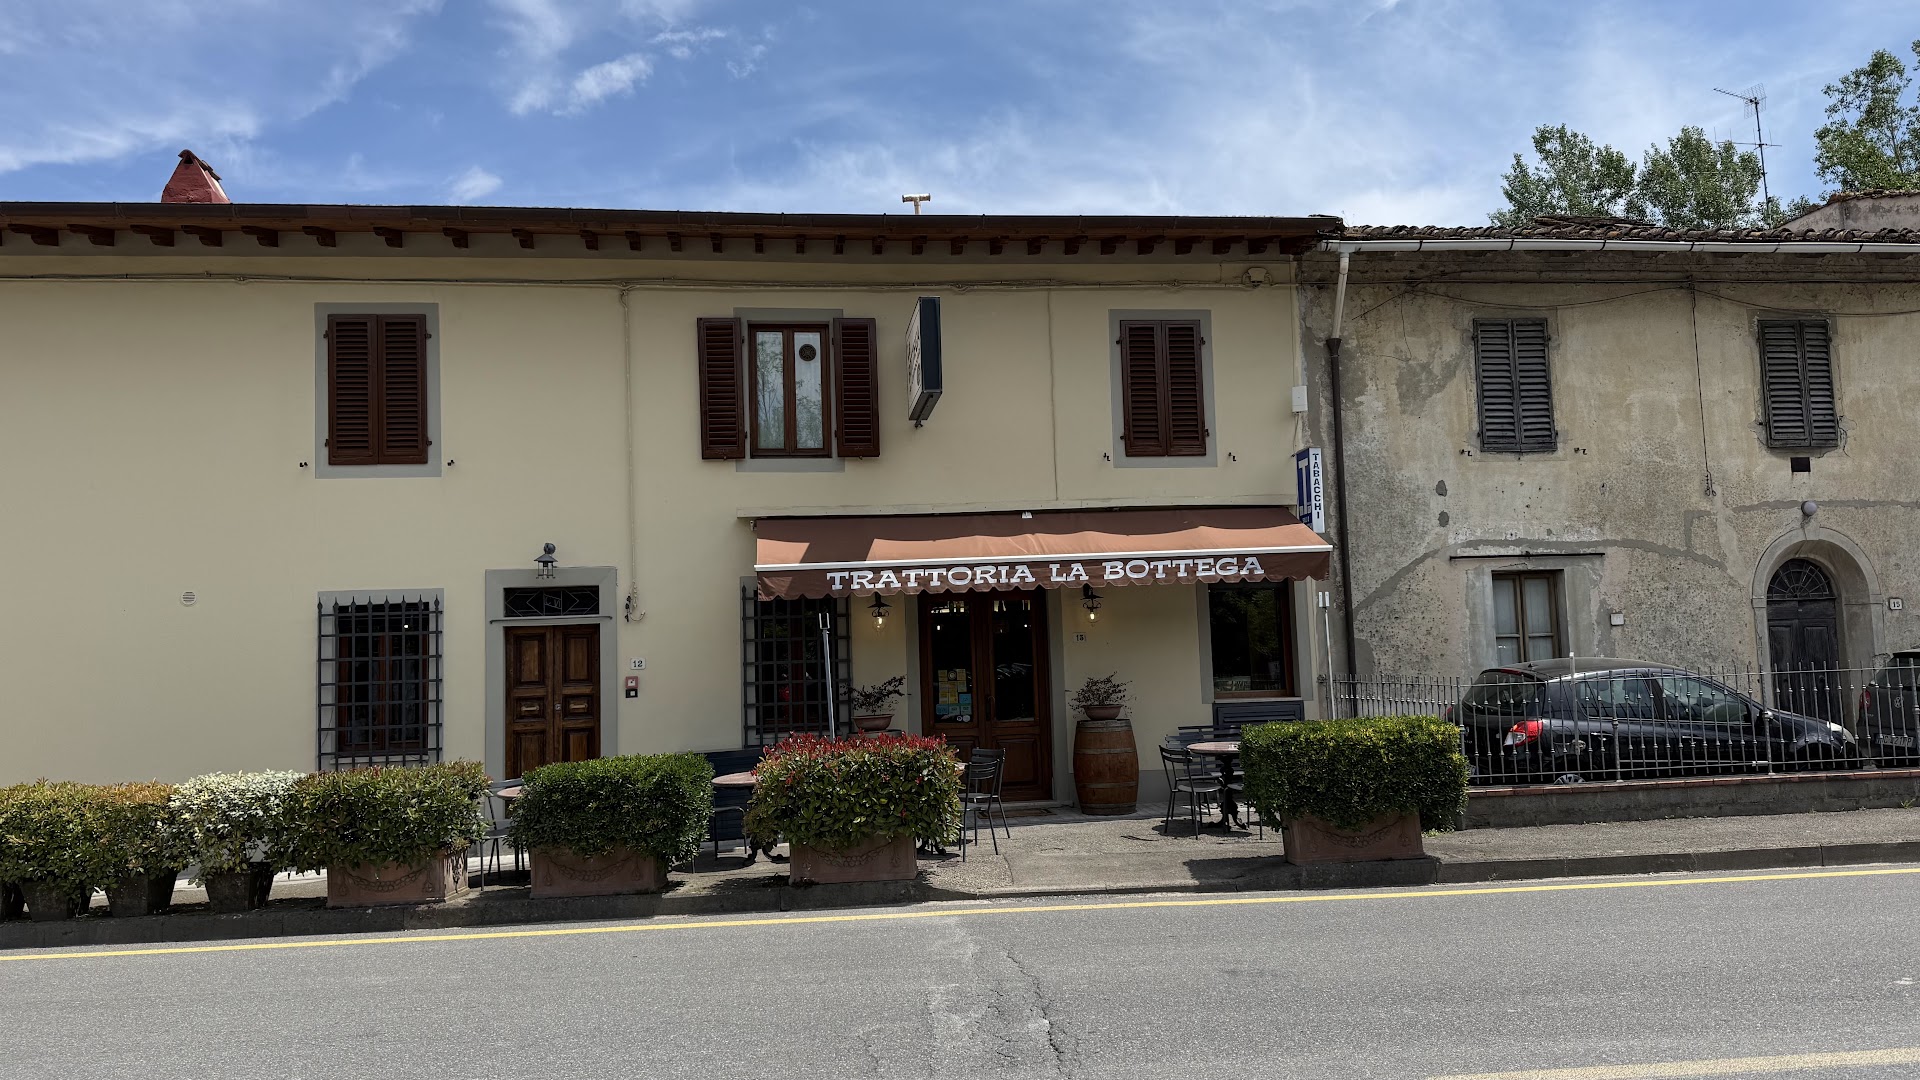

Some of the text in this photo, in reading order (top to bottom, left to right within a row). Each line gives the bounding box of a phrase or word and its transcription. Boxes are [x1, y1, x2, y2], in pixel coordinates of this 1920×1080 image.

[1312, 453, 1322, 519] TABACCHI
[826, 556, 1265, 590] TRATTORIA LA BOTTEGA
[632, 659, 643, 668] 12
